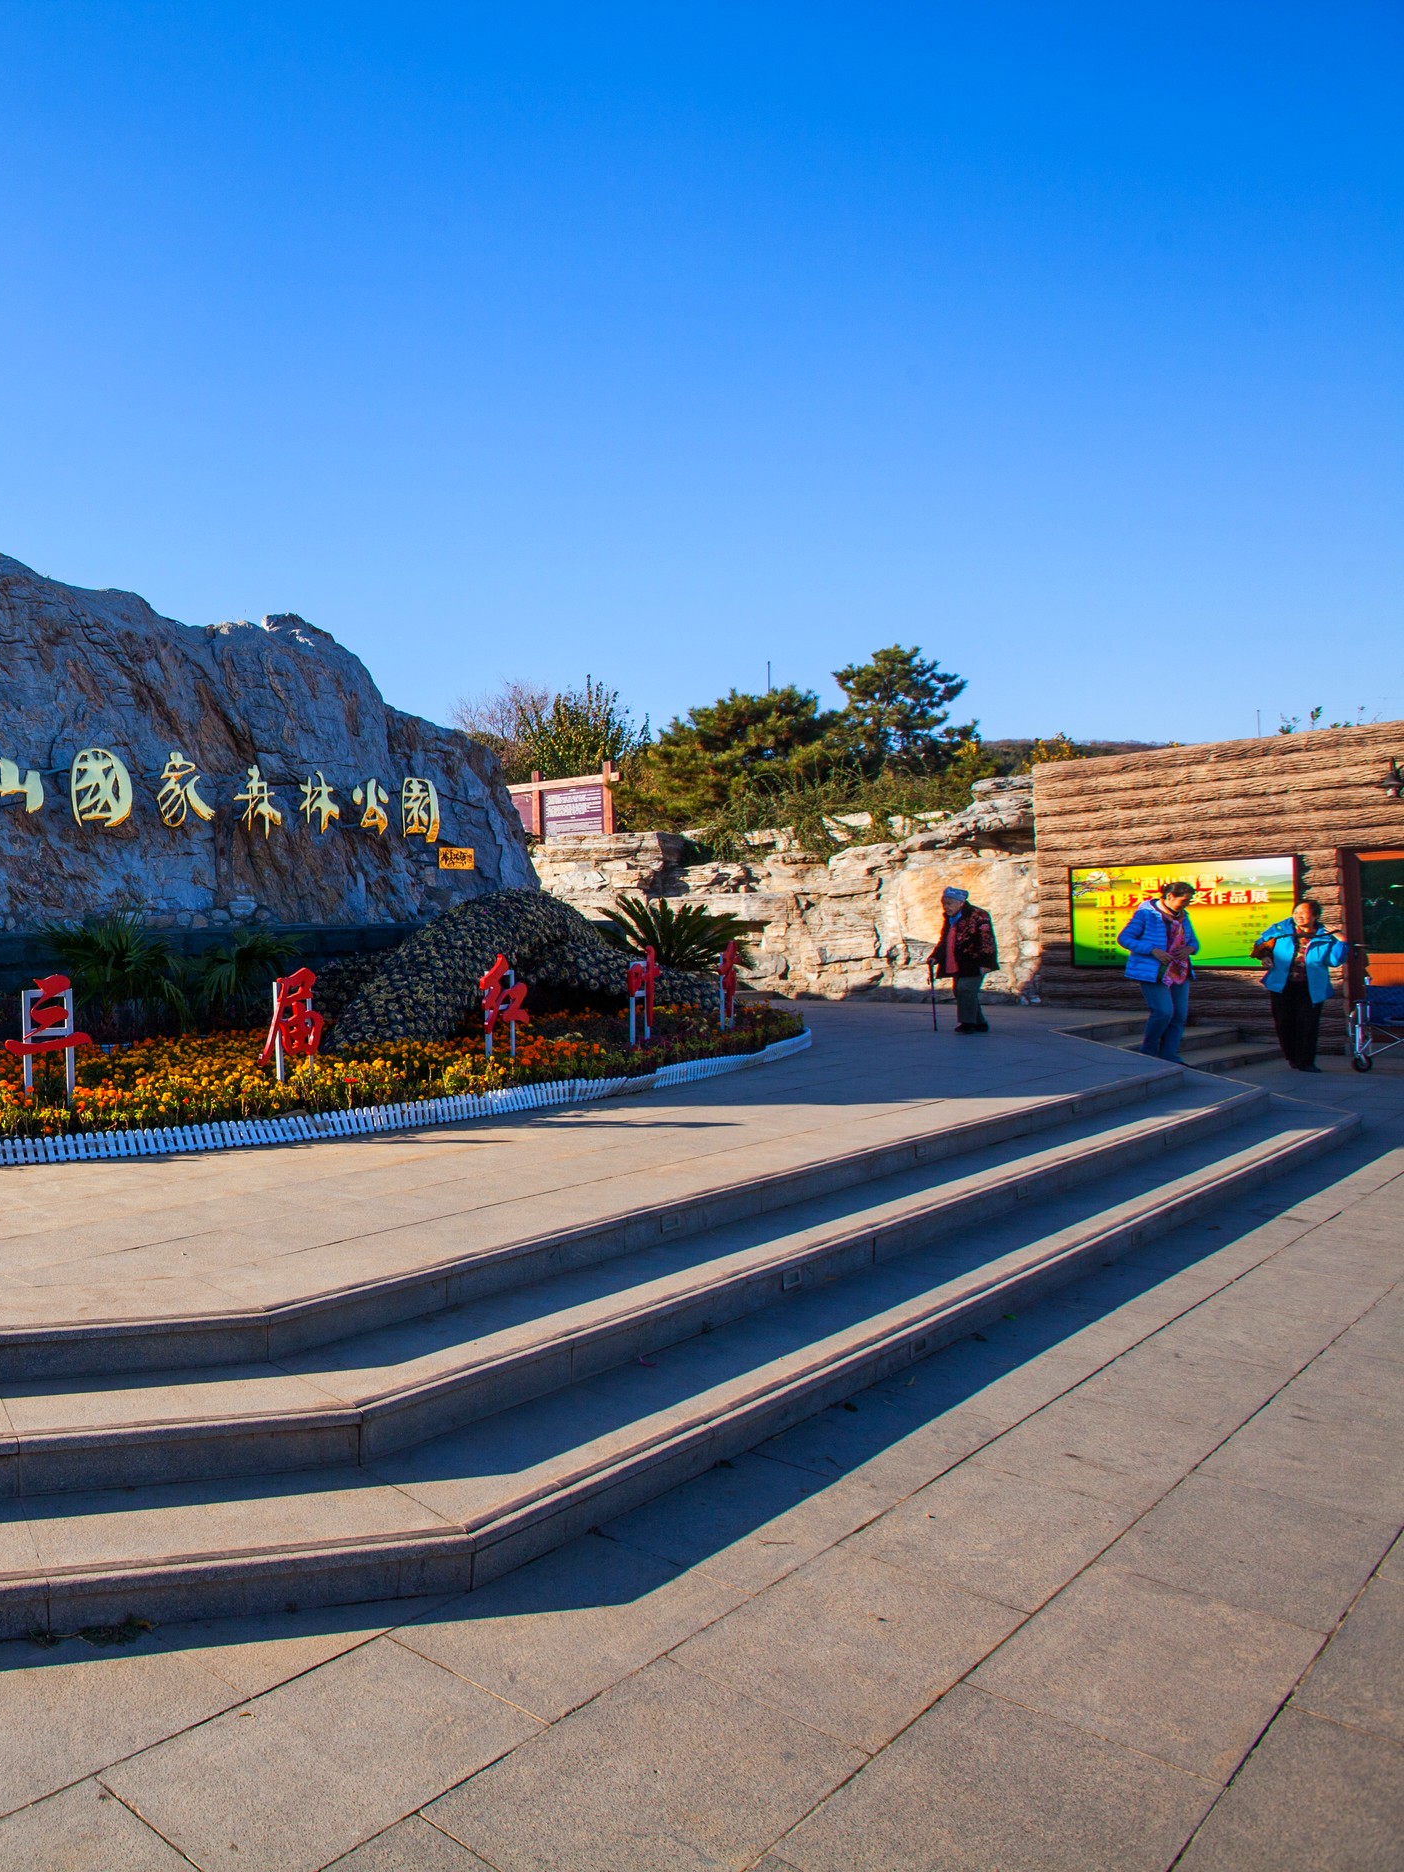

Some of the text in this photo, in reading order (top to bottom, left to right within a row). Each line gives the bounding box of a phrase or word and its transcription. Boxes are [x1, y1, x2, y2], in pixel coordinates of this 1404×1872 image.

[1097, 889, 1270, 907] 摄影大奖作品展
